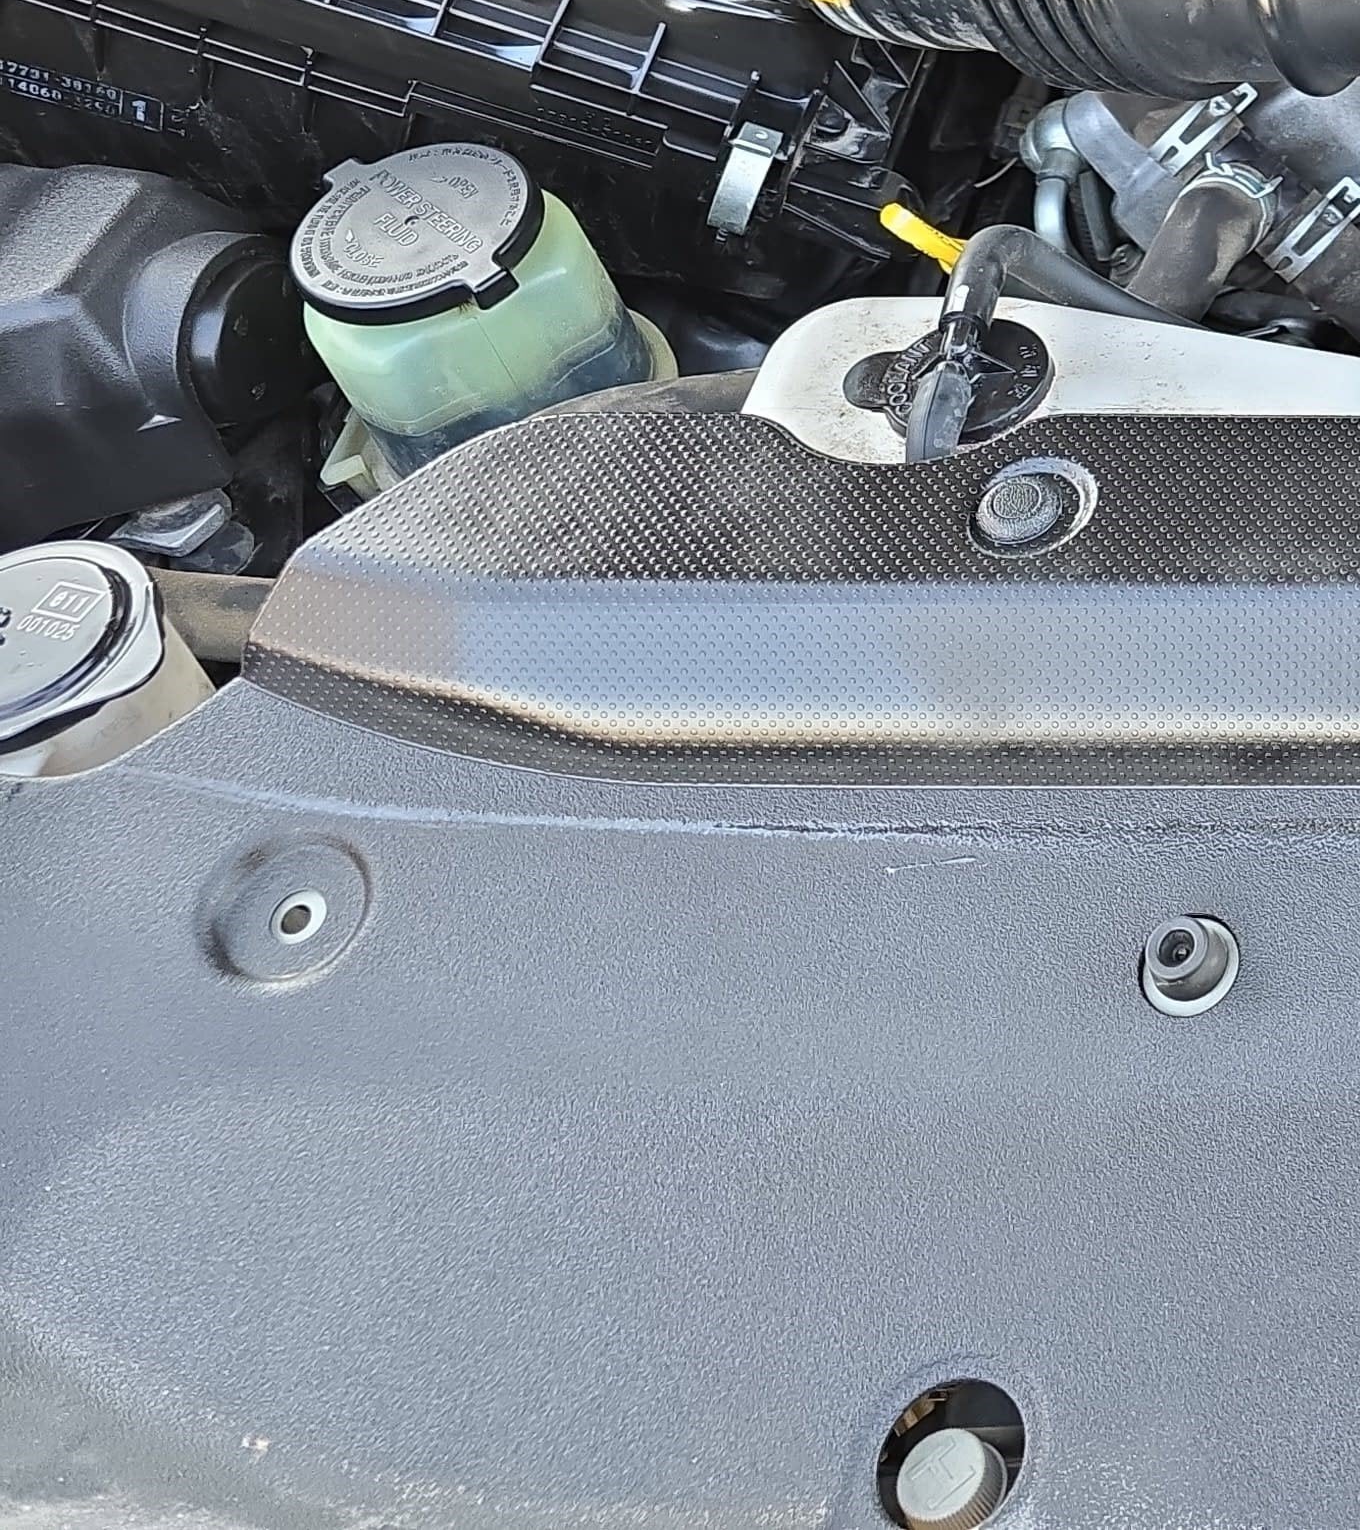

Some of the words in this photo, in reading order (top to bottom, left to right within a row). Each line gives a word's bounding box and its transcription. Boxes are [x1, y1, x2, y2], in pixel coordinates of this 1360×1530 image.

[447, 176, 480, 199] OPEN
[369, 169, 423, 210] POWER
[418, 200, 484, 254] STEERING
[373, 212, 420, 247] FLUID
[343, 243, 385, 269] CLOSE
[16, 614, 81, 642] 001025
